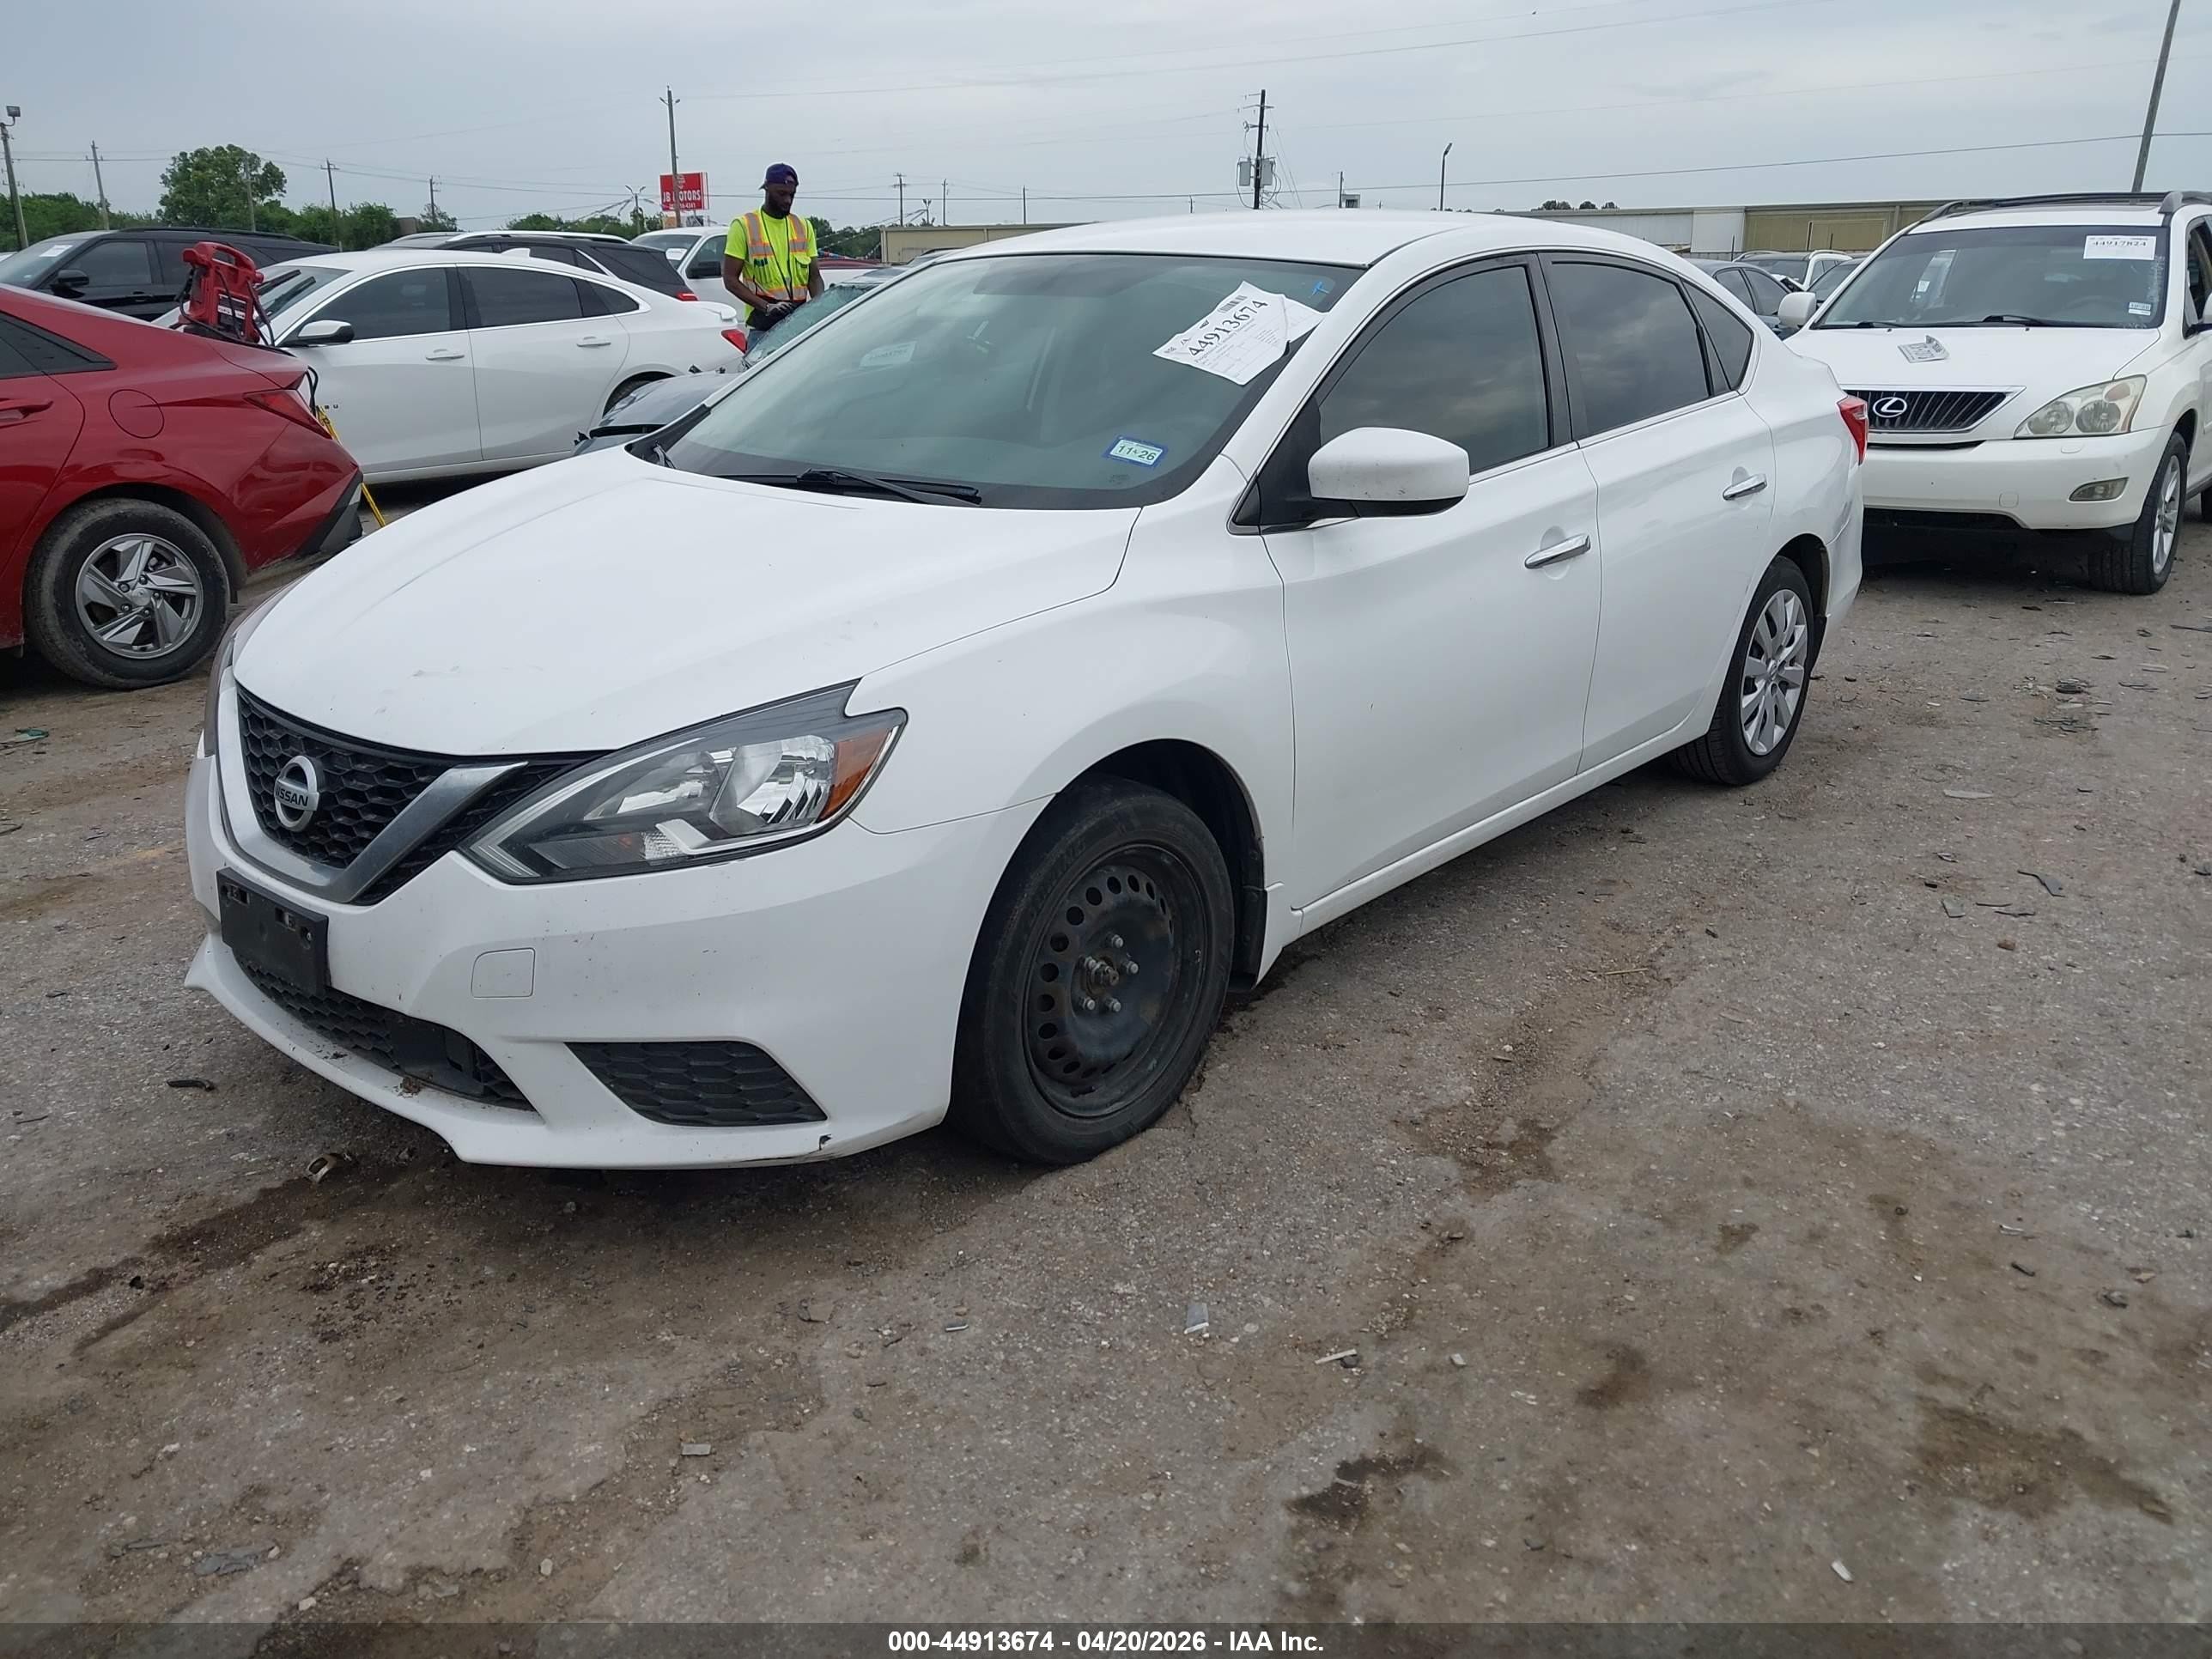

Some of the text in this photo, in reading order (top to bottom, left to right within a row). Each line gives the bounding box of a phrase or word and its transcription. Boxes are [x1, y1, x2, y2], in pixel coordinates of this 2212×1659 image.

[663, 191, 672, 203] JB
[1188, 301, 1267, 356] 44913674
[1139, 450, 1157, 460] 26
